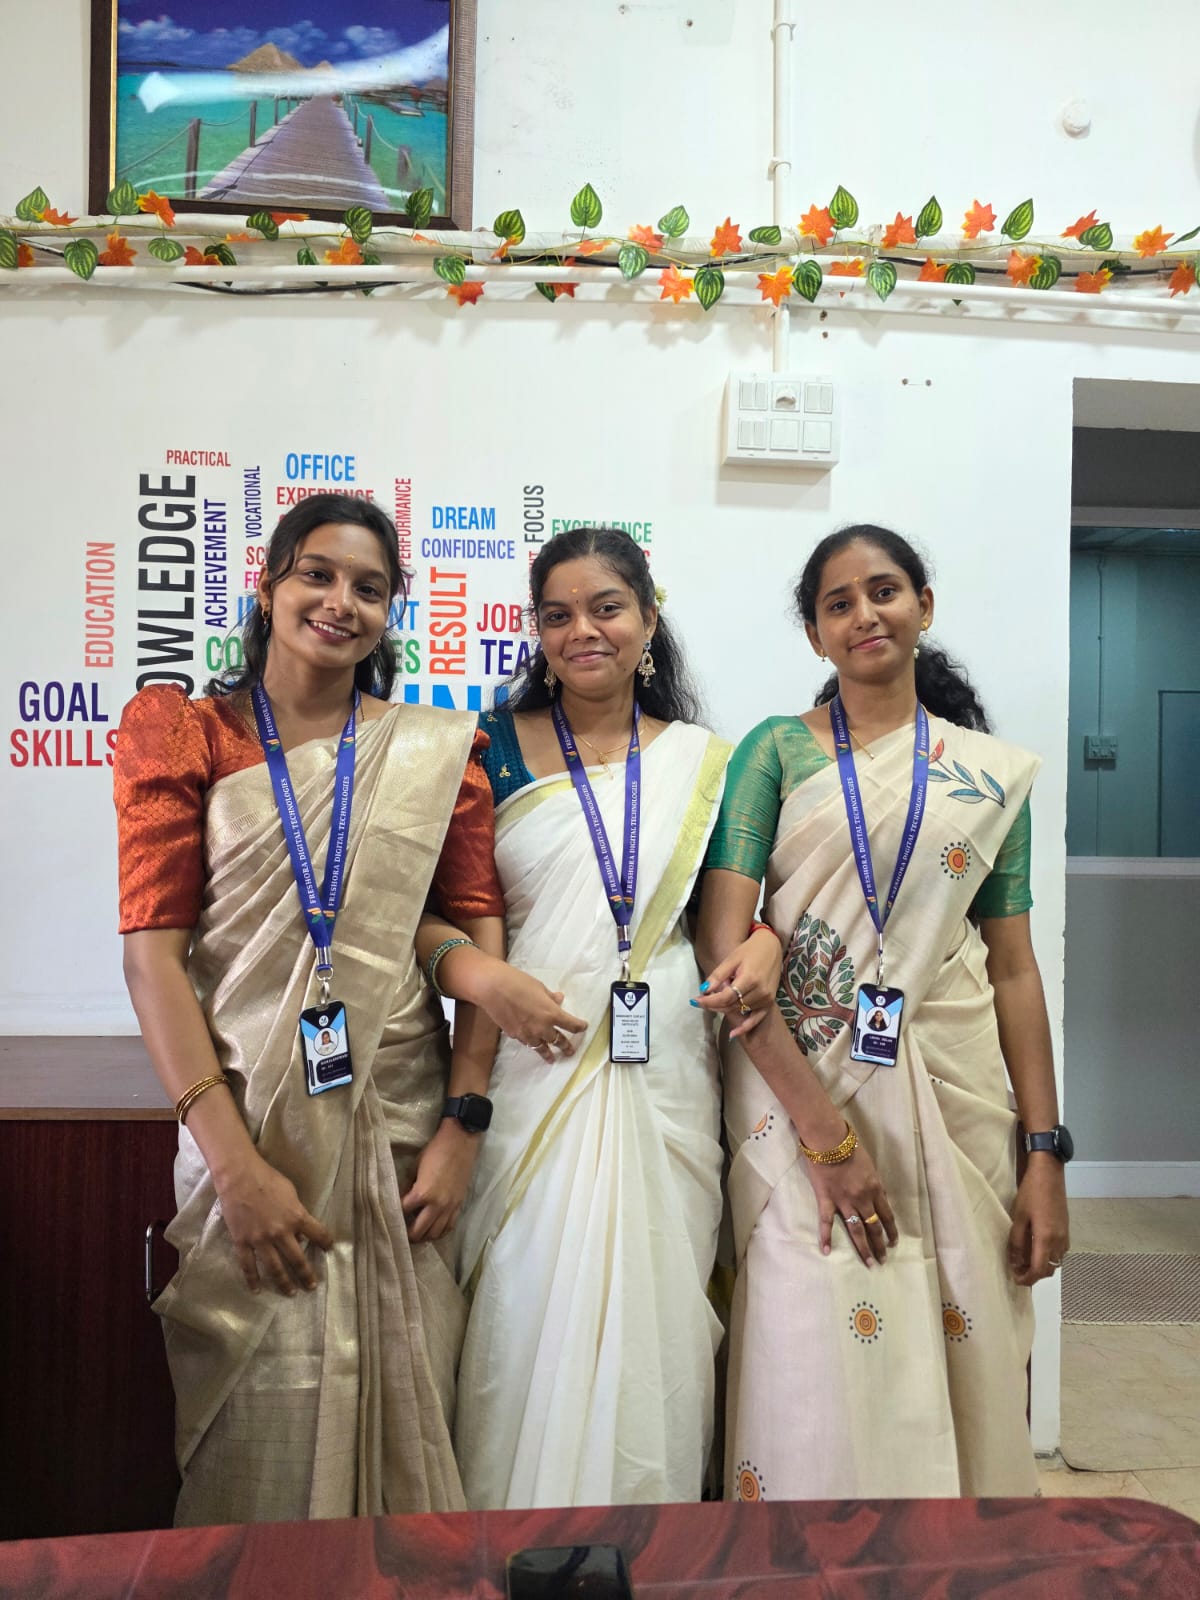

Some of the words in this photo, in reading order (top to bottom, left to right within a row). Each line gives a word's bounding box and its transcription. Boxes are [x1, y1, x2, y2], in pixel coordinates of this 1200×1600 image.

[166, 450, 231, 467] PRACTICAL
[286, 453, 356, 481] OFFICE
[243, 465, 262, 538] VOCATIONAL
[395, 478, 412, 568] PERFORMANCE
[432, 506, 496, 530] DREAM
[523, 484, 545, 543] FOCUS
[203, 498, 227, 628] ACHIEVEMENT
[421, 538, 516, 560] CONFIDENCE
[85, 541, 116, 668] EDUCATION
[136, 473, 197, 697] OWLEDGE
[429, 566, 467, 675] RESULT
[476, 603, 523, 633] JOB
[480, 639, 542, 676] TEA
[19, 681, 109, 722] GOAL
[280, 778, 299, 830] TECHNOLOGIES
[339, 775, 350, 830] TECHNOLOGIES
[294, 831, 307, 861] DIGITAL
[334, 832, 344, 862] DIGITAL
[302, 862, 317, 905] FRESHORA
[328, 864, 341, 907] FRESHORA
